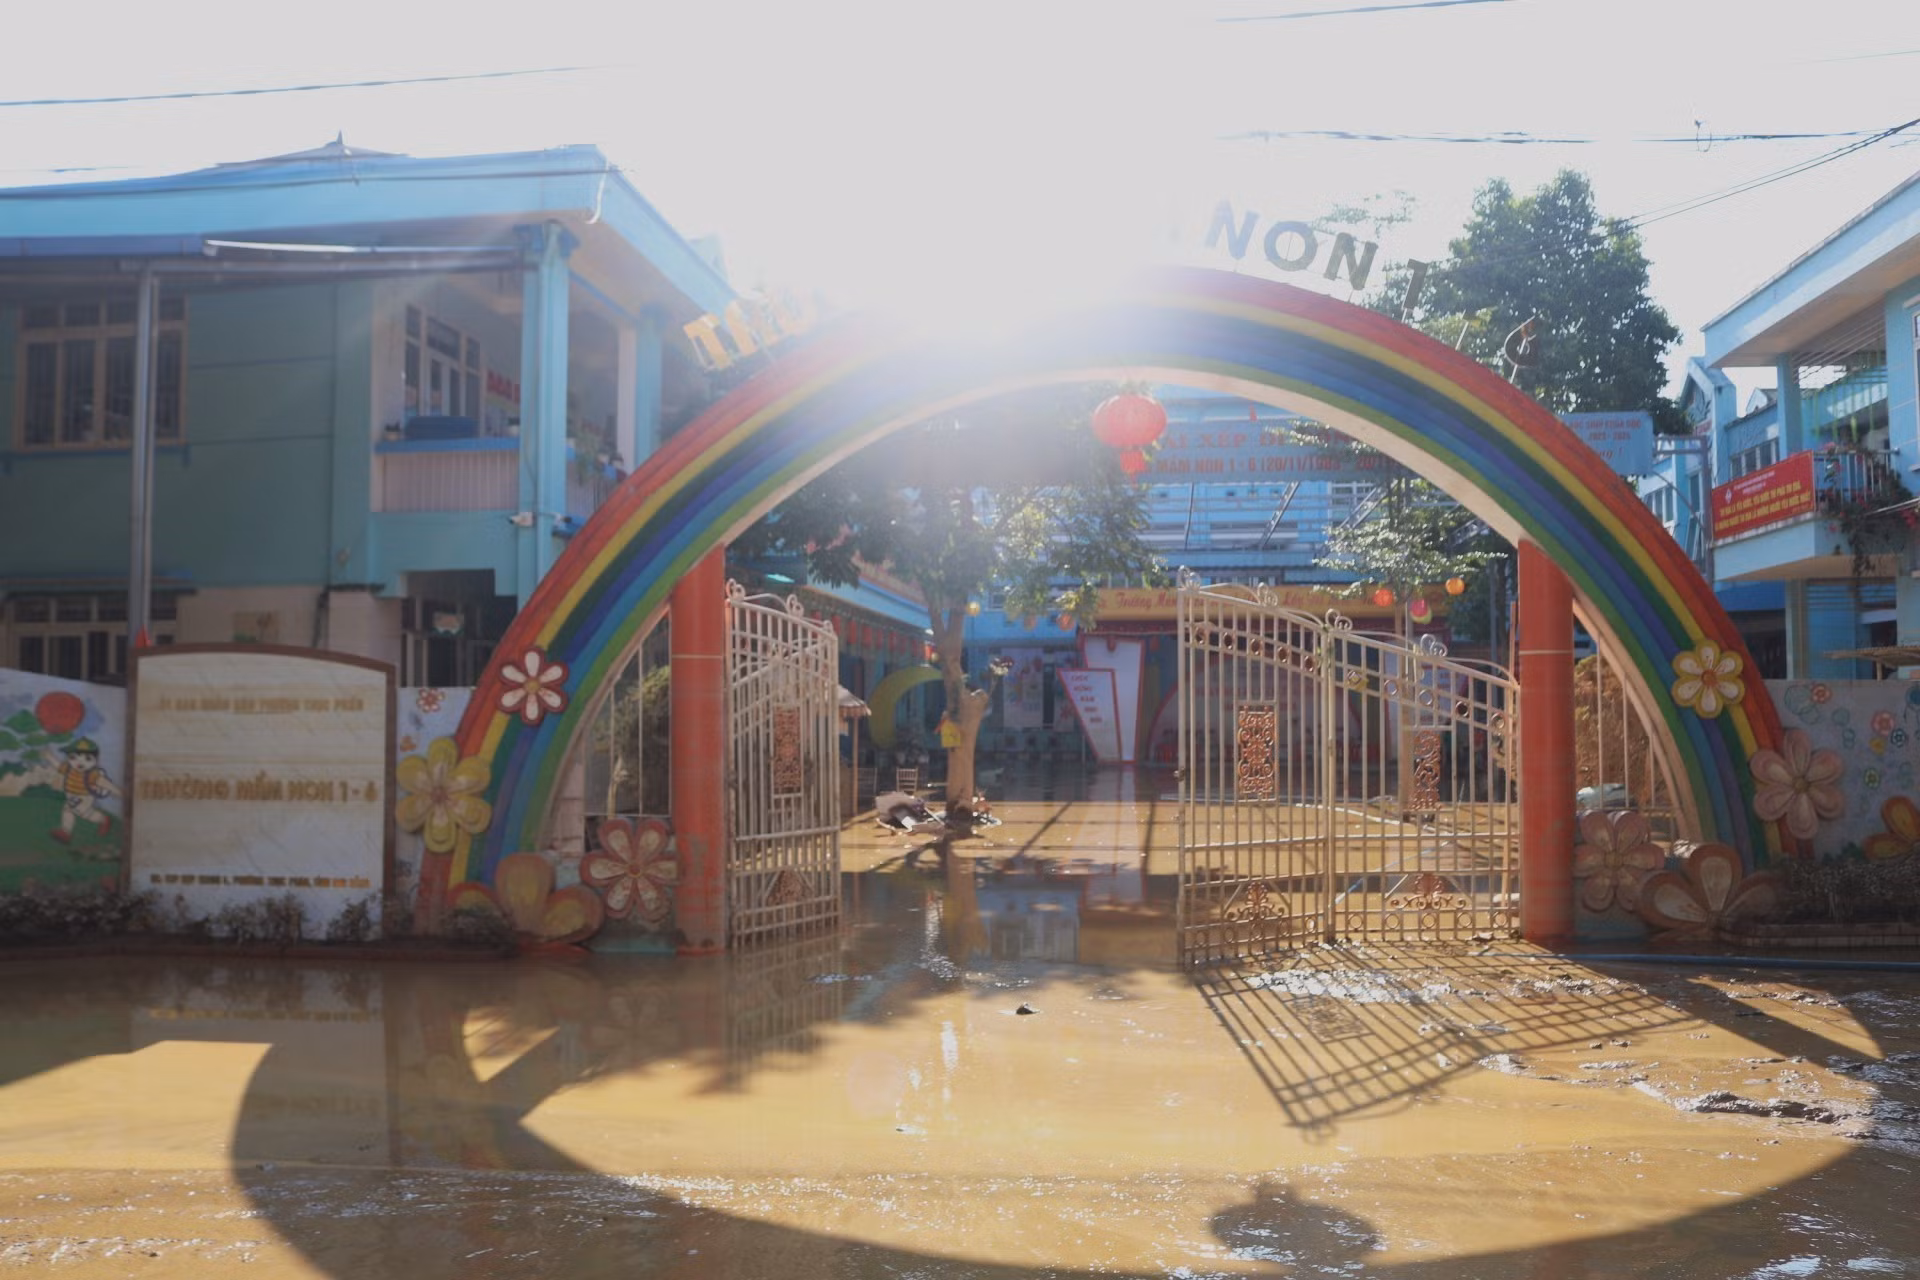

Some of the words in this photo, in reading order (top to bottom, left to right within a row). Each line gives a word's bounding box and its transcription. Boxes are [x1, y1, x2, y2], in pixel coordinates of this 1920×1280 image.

[1204, 199, 1379, 291] NON
[140, 772, 229, 801] TRƯỜNG
[288, 779, 333, 801] NON
[339, 781, 348, 802] 1
